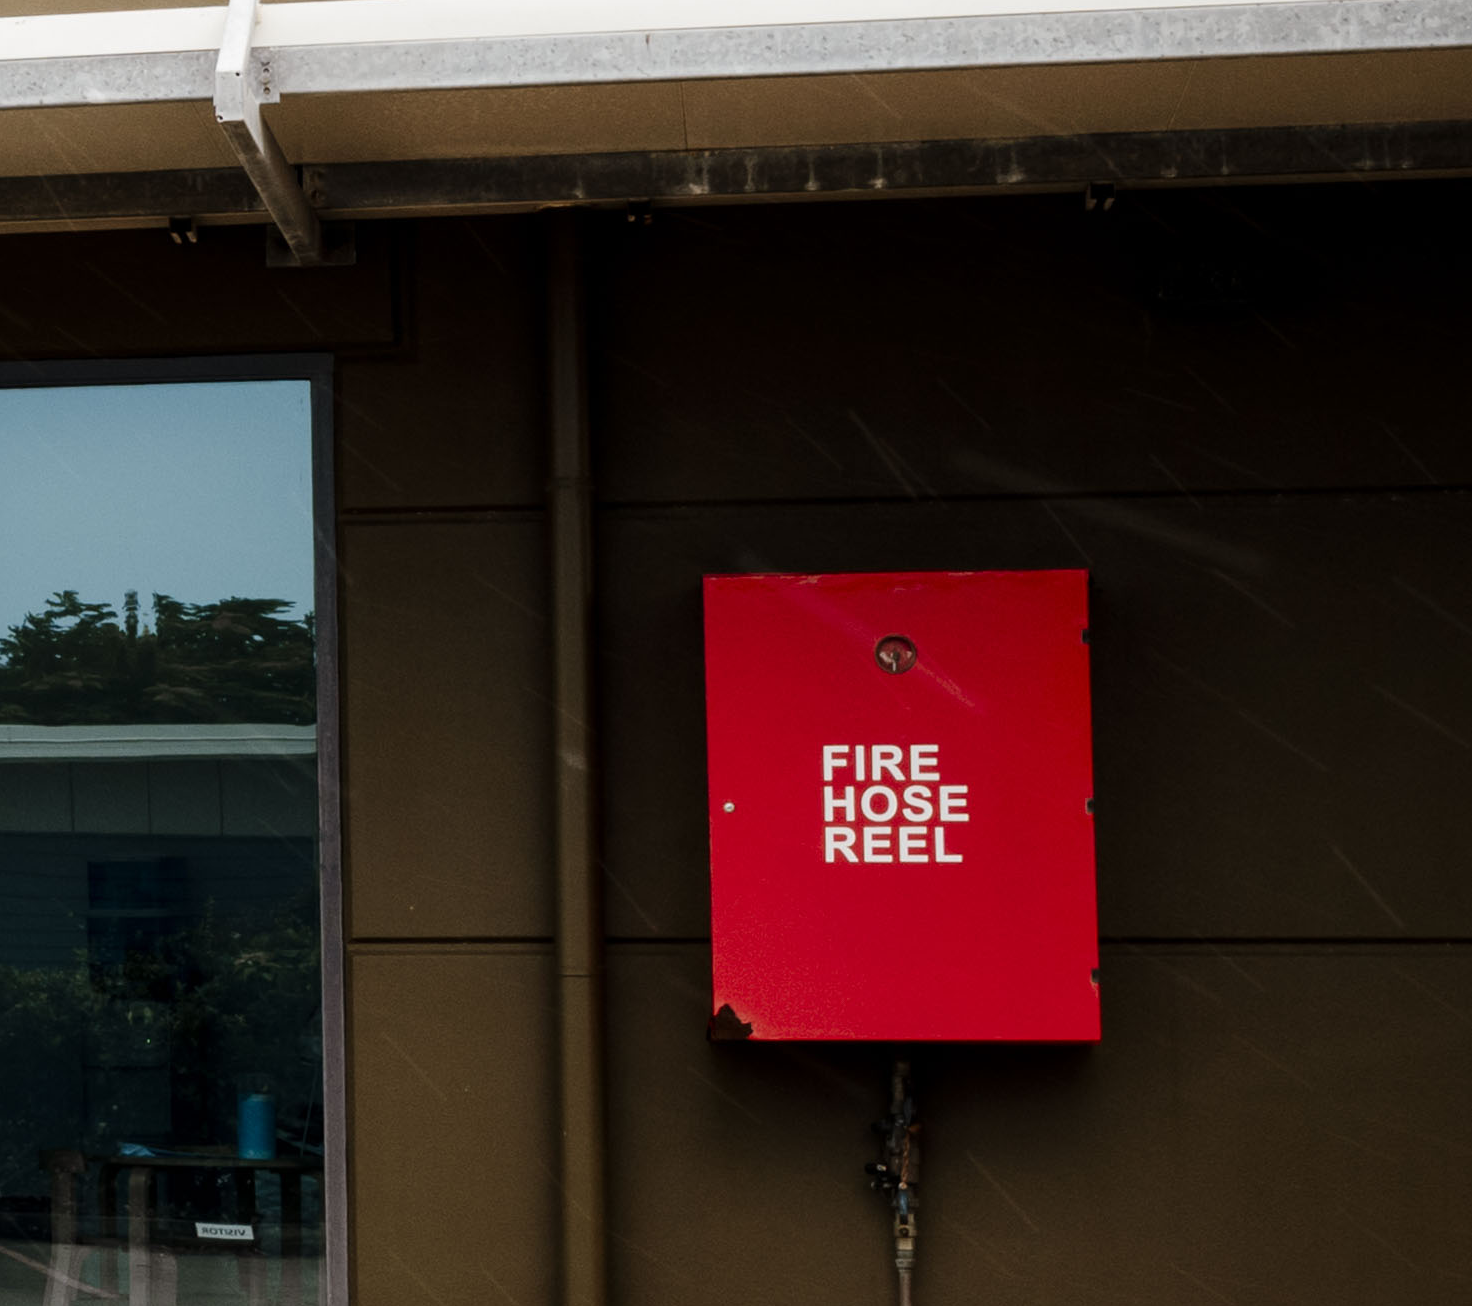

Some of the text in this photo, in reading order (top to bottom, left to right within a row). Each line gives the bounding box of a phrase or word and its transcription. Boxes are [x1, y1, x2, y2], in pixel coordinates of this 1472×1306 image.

[822, 744, 940, 781] FIRE
[823, 786, 969, 822] HOSE
[825, 827, 963, 863] REEL
